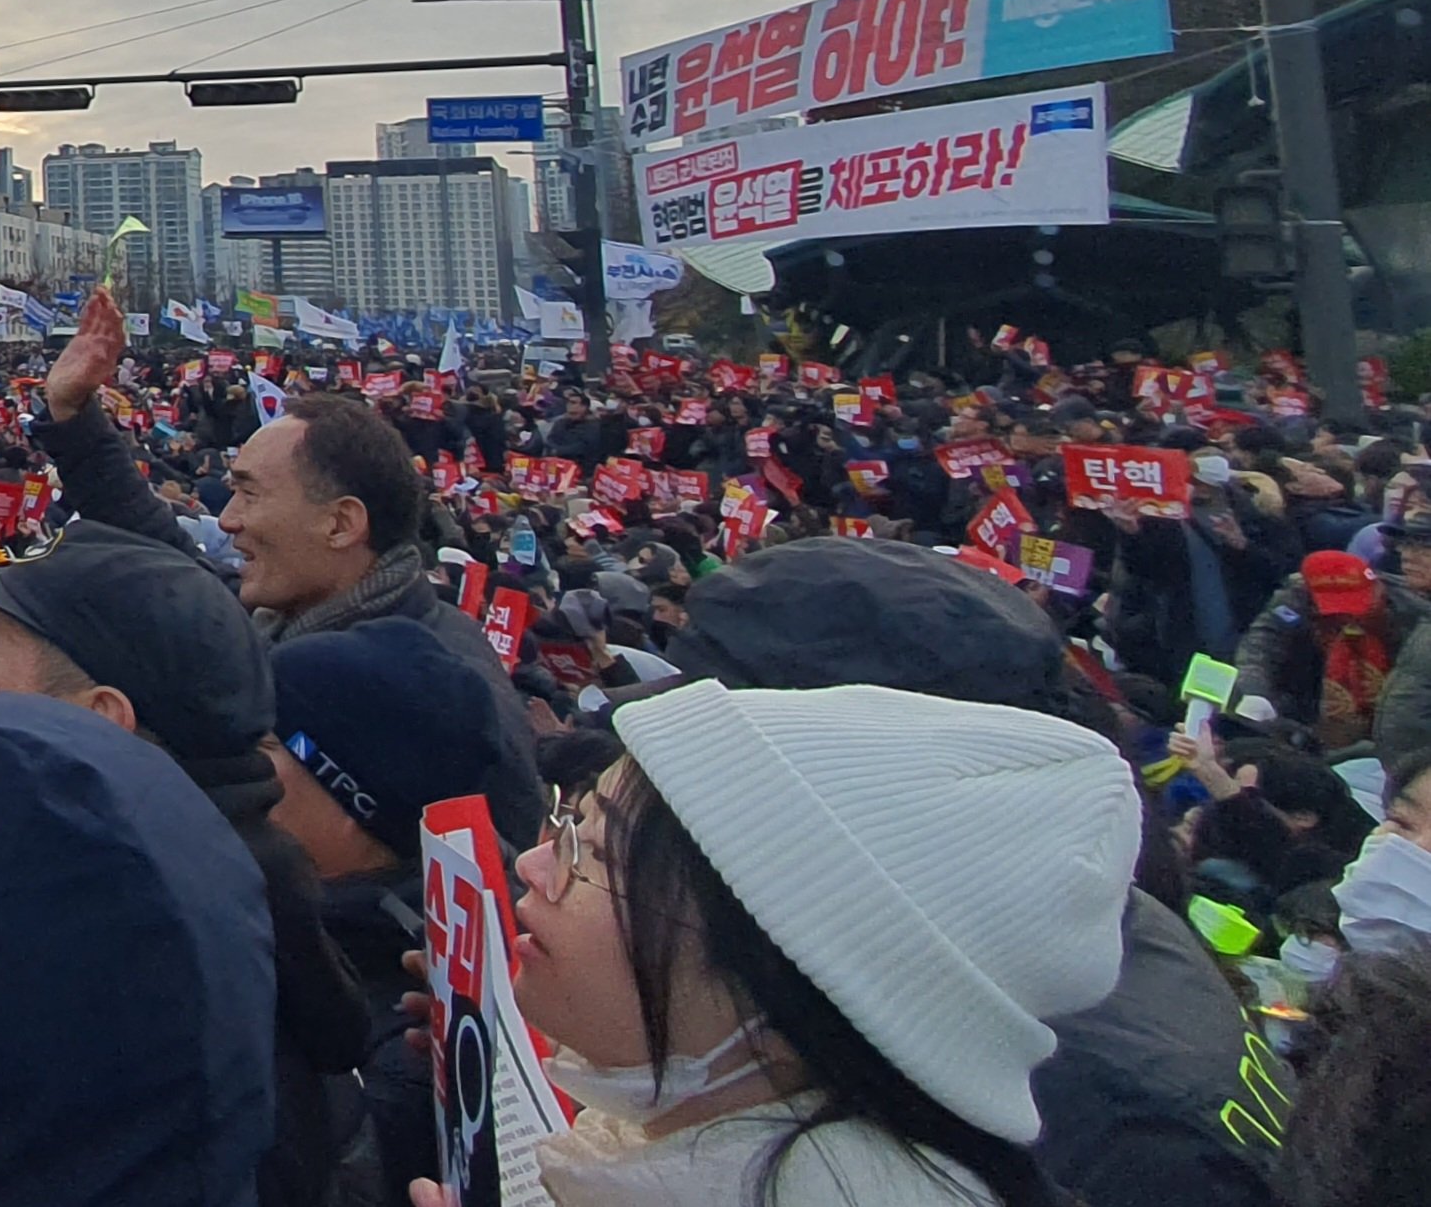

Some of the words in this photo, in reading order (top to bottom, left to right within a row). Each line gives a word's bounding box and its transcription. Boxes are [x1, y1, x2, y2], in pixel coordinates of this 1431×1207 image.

[628, 53, 670, 104] 내란
[674, 3, 814, 137] 윤석열
[651, 191, 707, 244] 현행범
[826, 123, 1029, 210] 체포하라!
[1083, 458, 1163, 495] 탄핵
